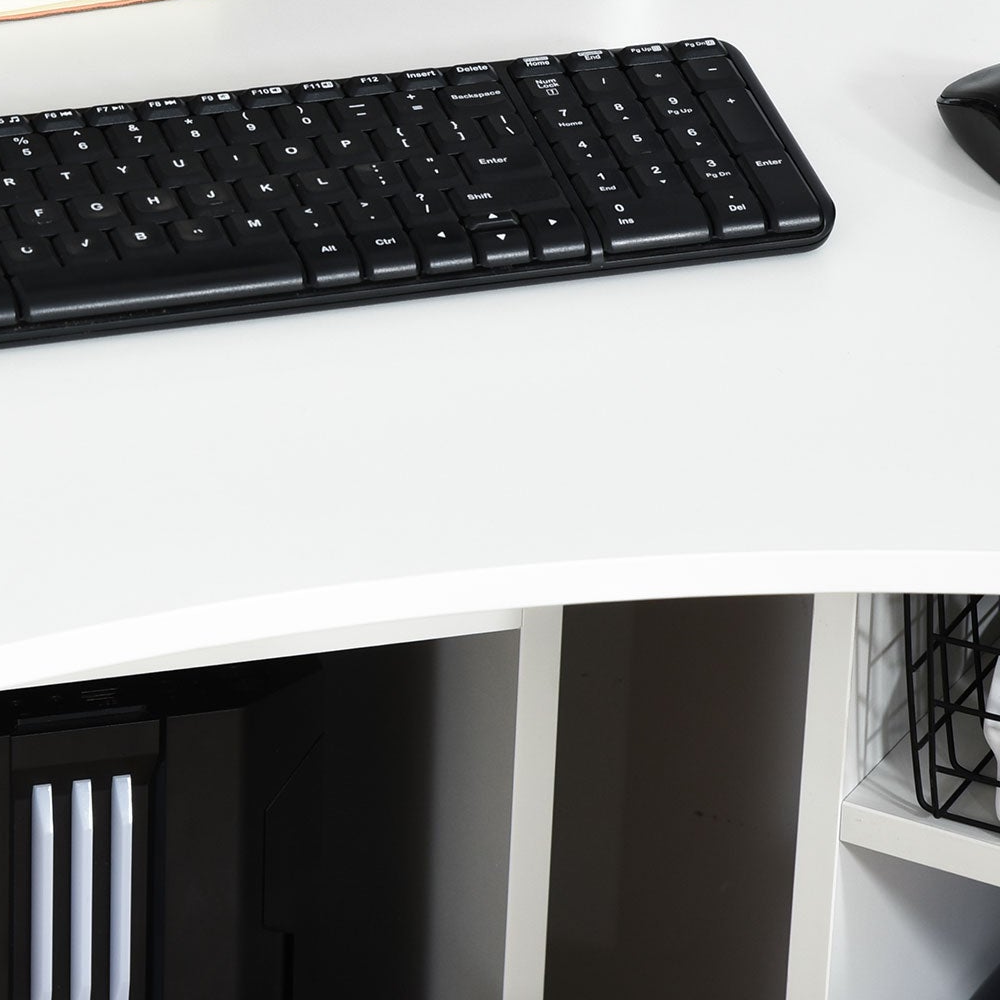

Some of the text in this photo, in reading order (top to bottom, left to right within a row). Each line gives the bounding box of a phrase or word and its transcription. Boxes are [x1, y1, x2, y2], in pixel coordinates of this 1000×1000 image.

[456, 64, 489, 72] Delete
[406, 69, 436, 78] Insert
[451, 91, 501, 99] Backspace
[614, 103, 624, 111] 8
[341, 140, 351, 148] P
[22, 148, 31, 156] 5
[173, 159, 185, 167] U
[651, 166, 661, 174] 2
[60, 172, 70, 180] T
[3, 178, 16, 186] R
[260, 184, 273, 192] K
[207, 190, 215, 198] J
[147, 196, 160, 205] H
[91, 203, 103, 211] G
[34, 209, 43, 217] F
[247, 219, 261, 227] M
[135, 232, 147, 240] B
